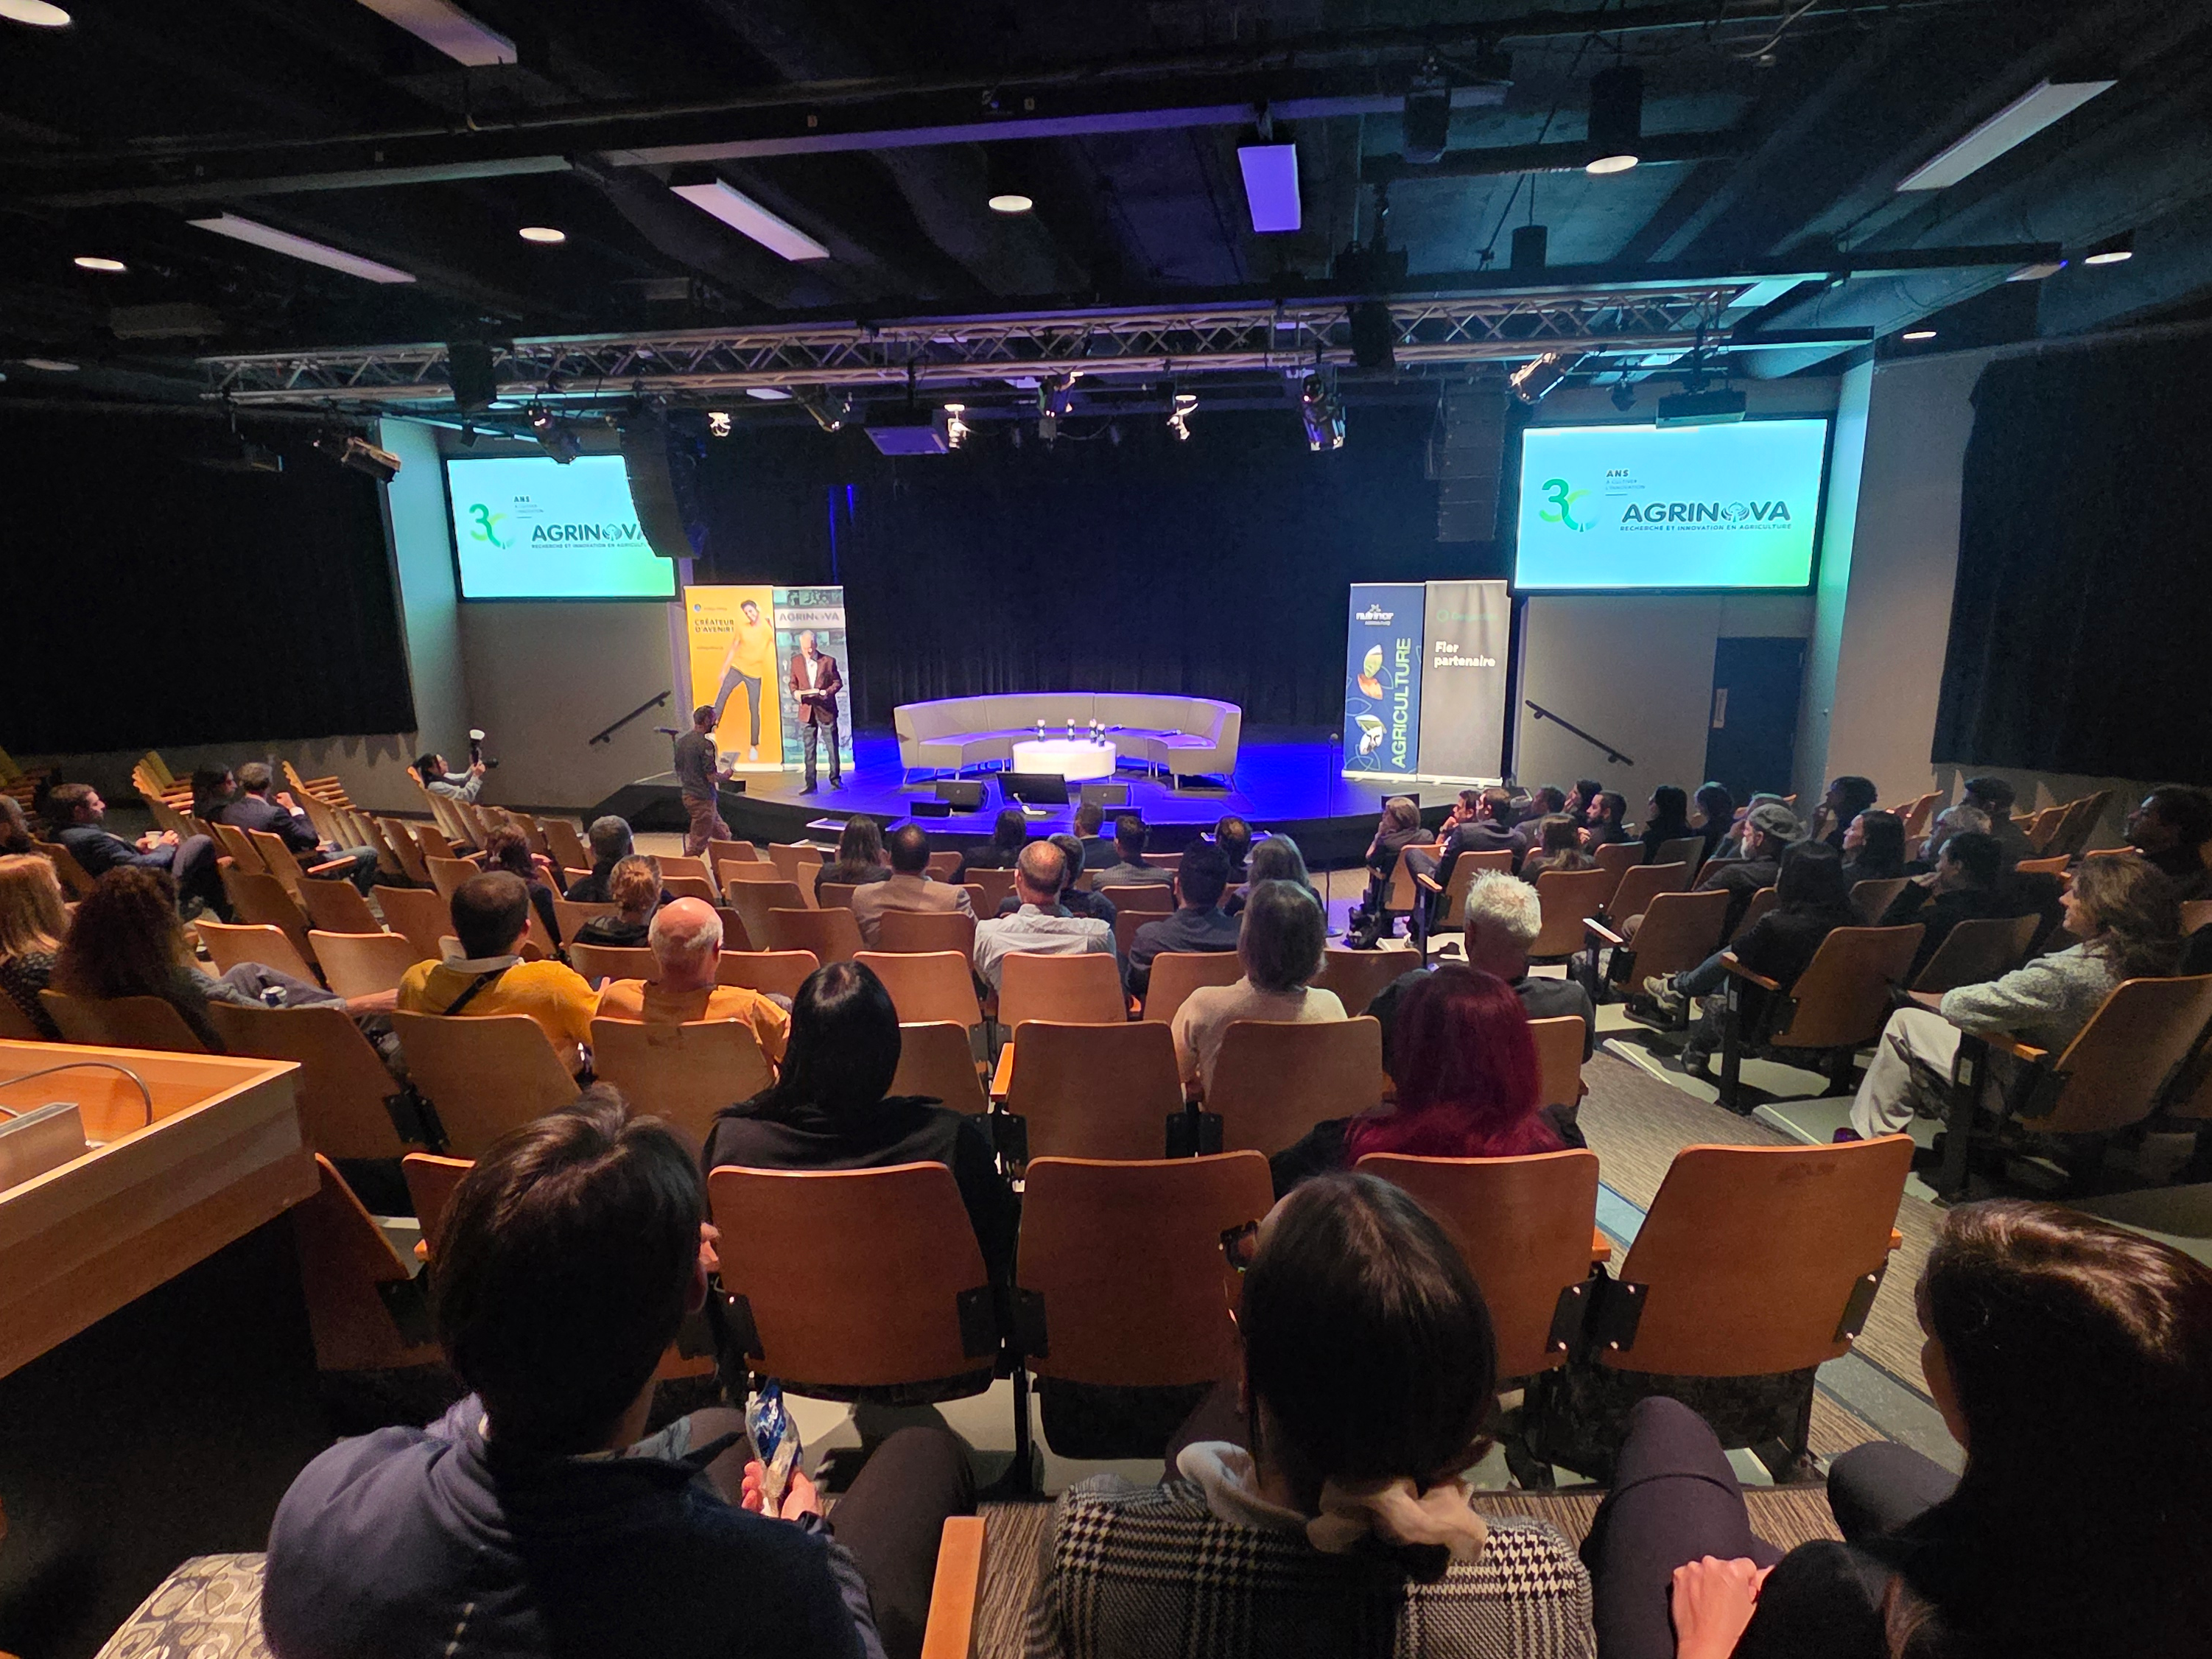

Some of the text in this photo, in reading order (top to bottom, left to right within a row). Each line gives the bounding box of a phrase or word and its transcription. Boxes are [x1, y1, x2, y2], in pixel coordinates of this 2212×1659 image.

[1606, 469, 1629, 477] ANS
[1621, 501, 1791, 523] AGRINOVA
[779, 612, 840, 622] AGRINOVA
[1435, 640, 1460, 653] Fier
[1433, 654, 1496, 668] partenaire
[1391, 637, 1411, 768] AGRICULTURE
